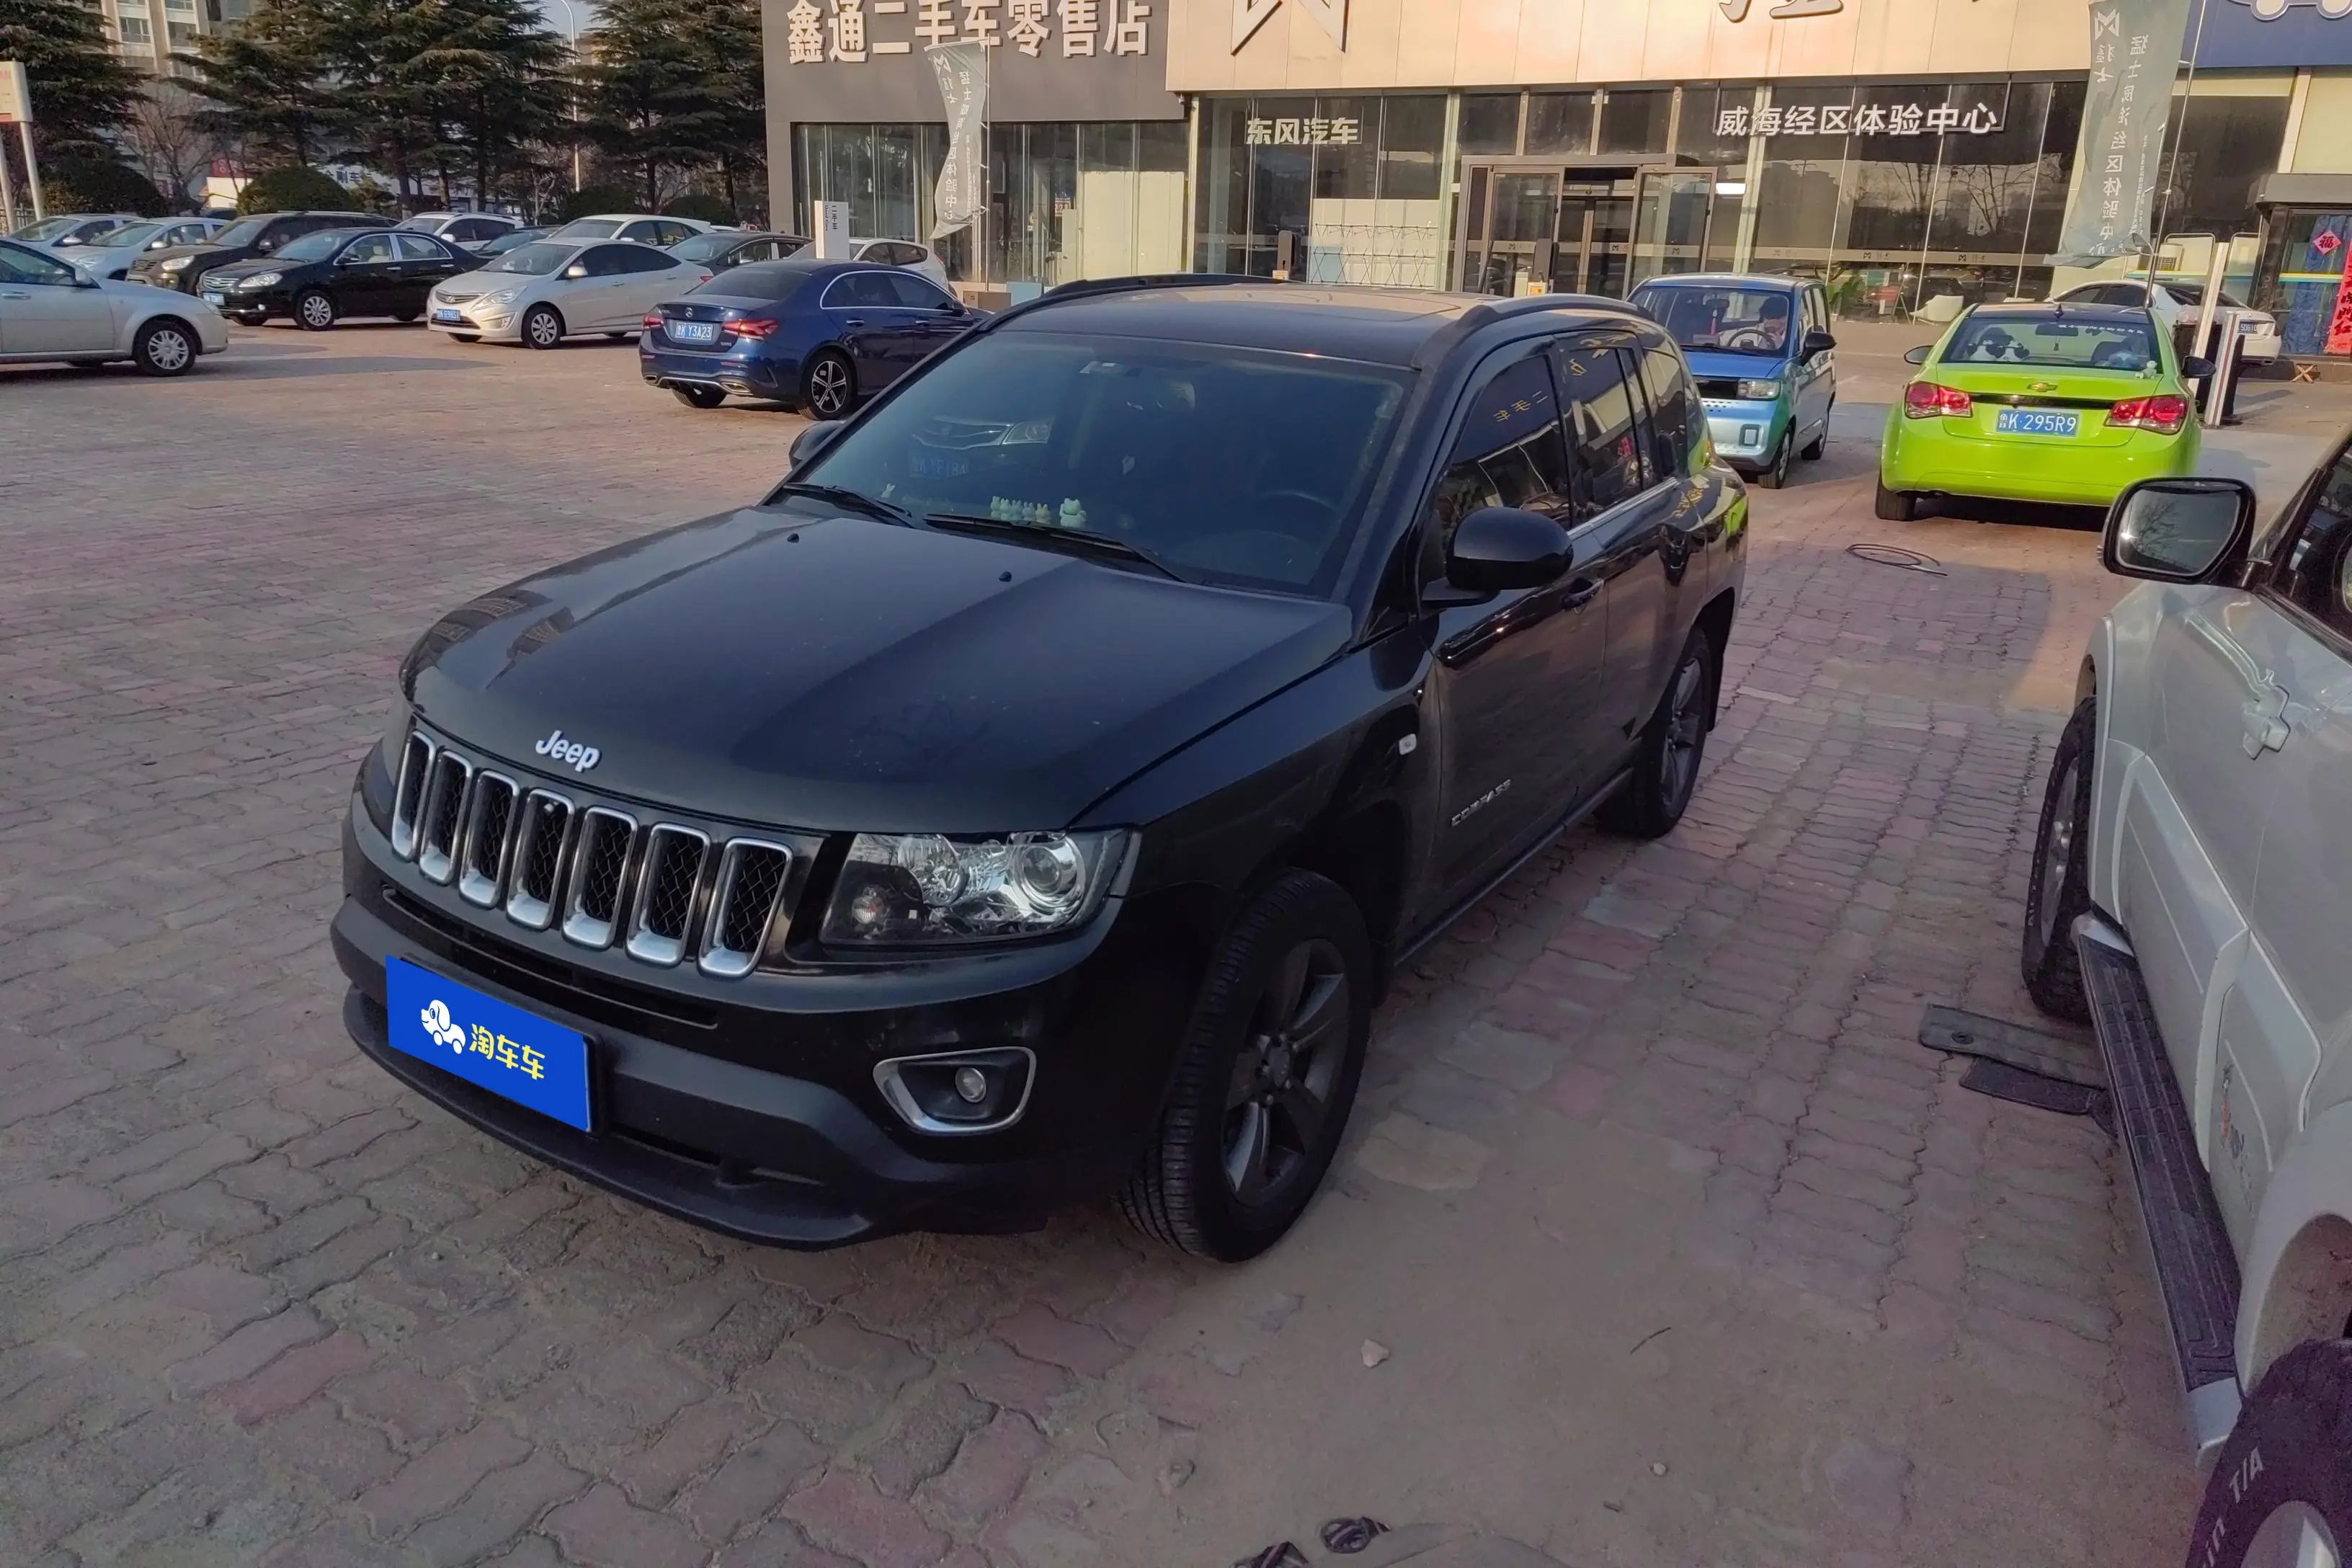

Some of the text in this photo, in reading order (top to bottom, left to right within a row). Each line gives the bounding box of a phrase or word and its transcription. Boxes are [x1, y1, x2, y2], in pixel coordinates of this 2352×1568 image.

[787, 0, 1152, 63] 鑫通二手车零售店
[1247, 117, 1358, 144] 东风汽车
[1716, 102, 1997, 136] 威海经区体验中心
[2319, 236, 2335, 249] 福
[535, 729, 600, 772] Jeep
[1451, 779, 1511, 827] COMPASS
